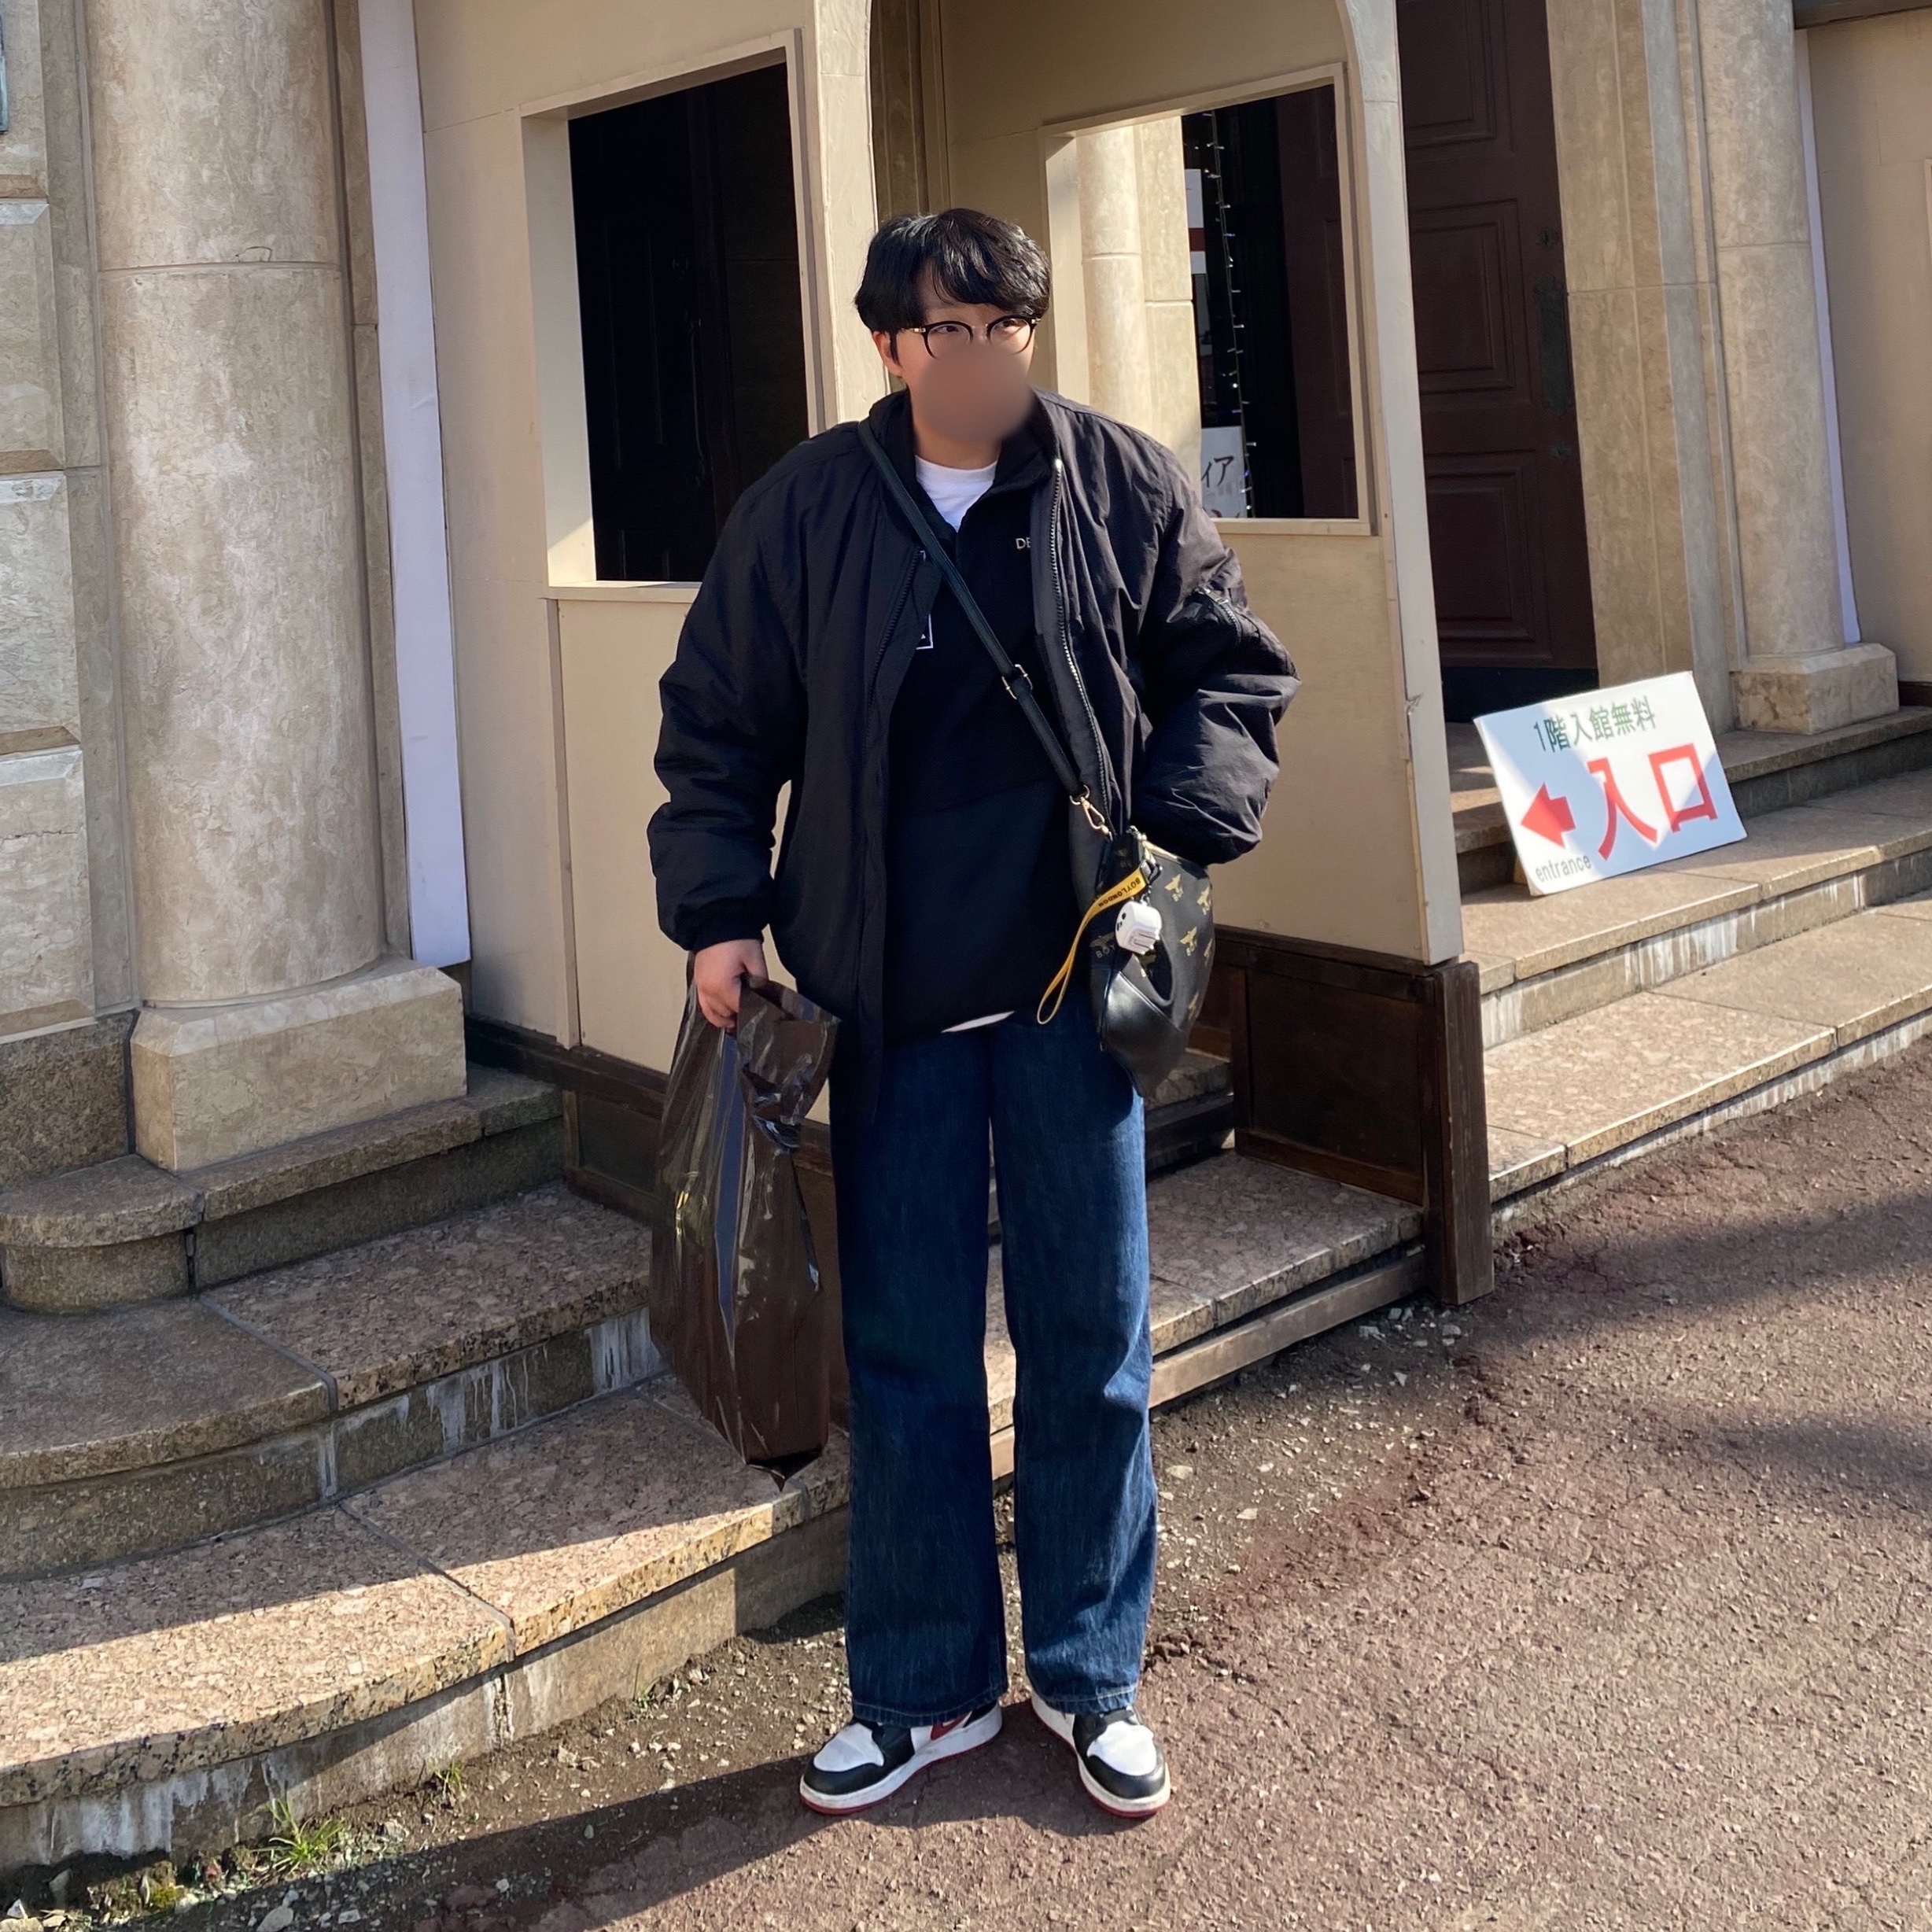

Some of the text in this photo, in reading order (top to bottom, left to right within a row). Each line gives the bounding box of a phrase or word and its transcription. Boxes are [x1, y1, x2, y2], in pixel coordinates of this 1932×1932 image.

[1534, 696, 1656, 753] 1階入館無料
[1587, 743, 1718, 860] 入口
[1536, 855, 1591, 882] entrance
